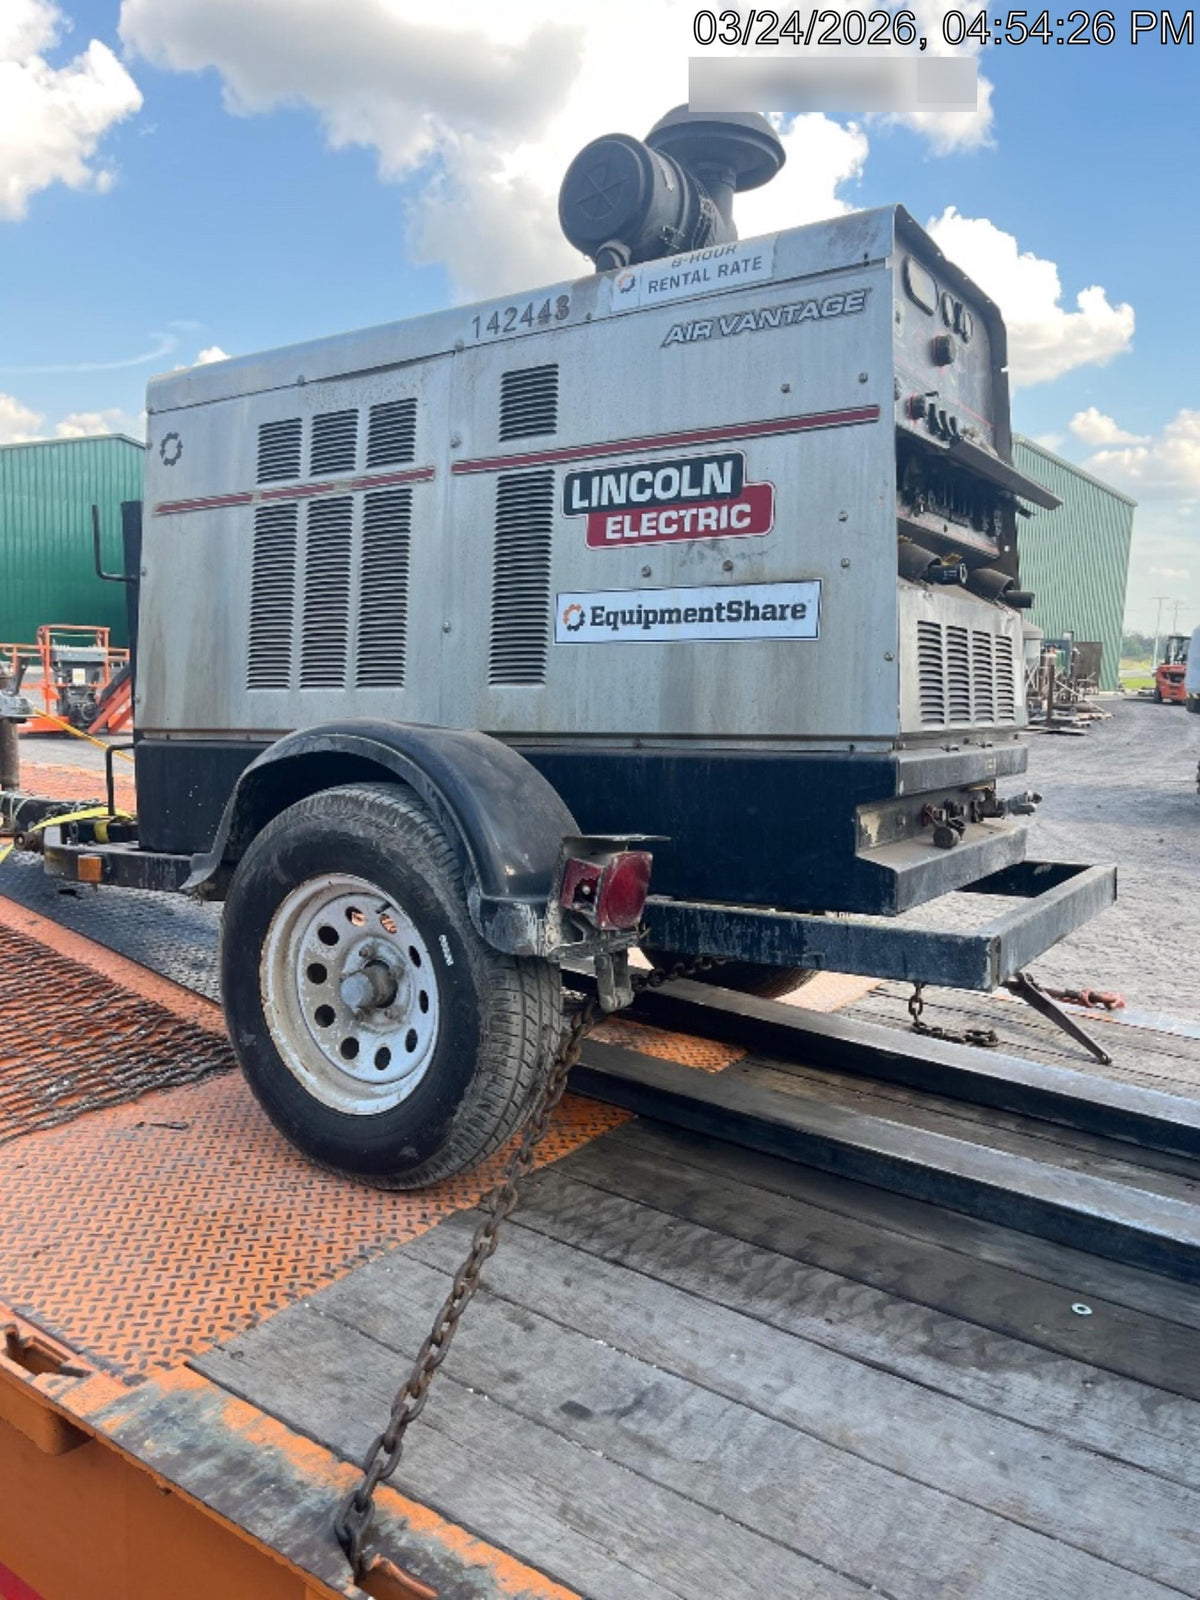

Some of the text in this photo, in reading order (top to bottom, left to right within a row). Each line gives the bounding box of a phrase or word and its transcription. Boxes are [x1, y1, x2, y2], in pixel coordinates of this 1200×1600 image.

[648, 255, 763, 294] RENTAL RATE
[660, 288, 872, 347] AIR VANTAGE
[571, 460, 733, 509] LINCOLN
[605, 503, 752, 540] ELECTRIC
[589, 600, 807, 631] EquipmentShare
